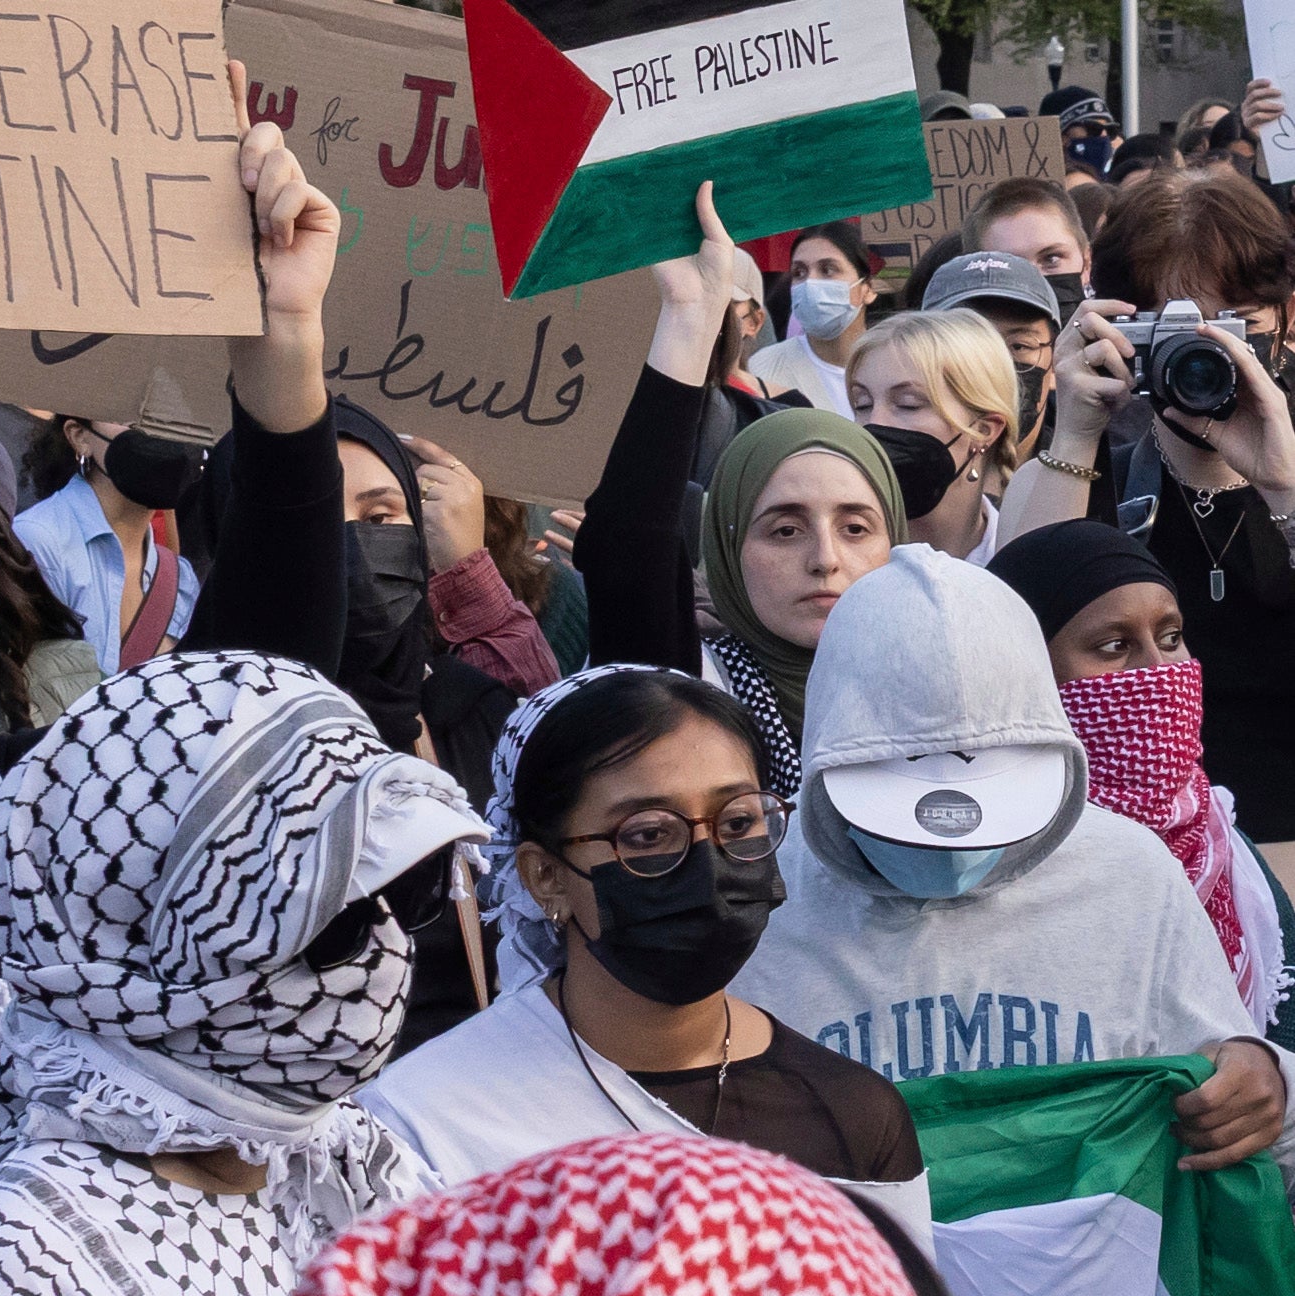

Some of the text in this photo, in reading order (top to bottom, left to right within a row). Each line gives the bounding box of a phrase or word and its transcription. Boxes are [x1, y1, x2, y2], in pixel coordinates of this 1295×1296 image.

[612, 21, 839, 115] FREE PALESTINE
[310, 96, 359, 166] for
[930, 120, 1049, 179] EDOM &
[816, 992, 1095, 1083] LUMBIA
